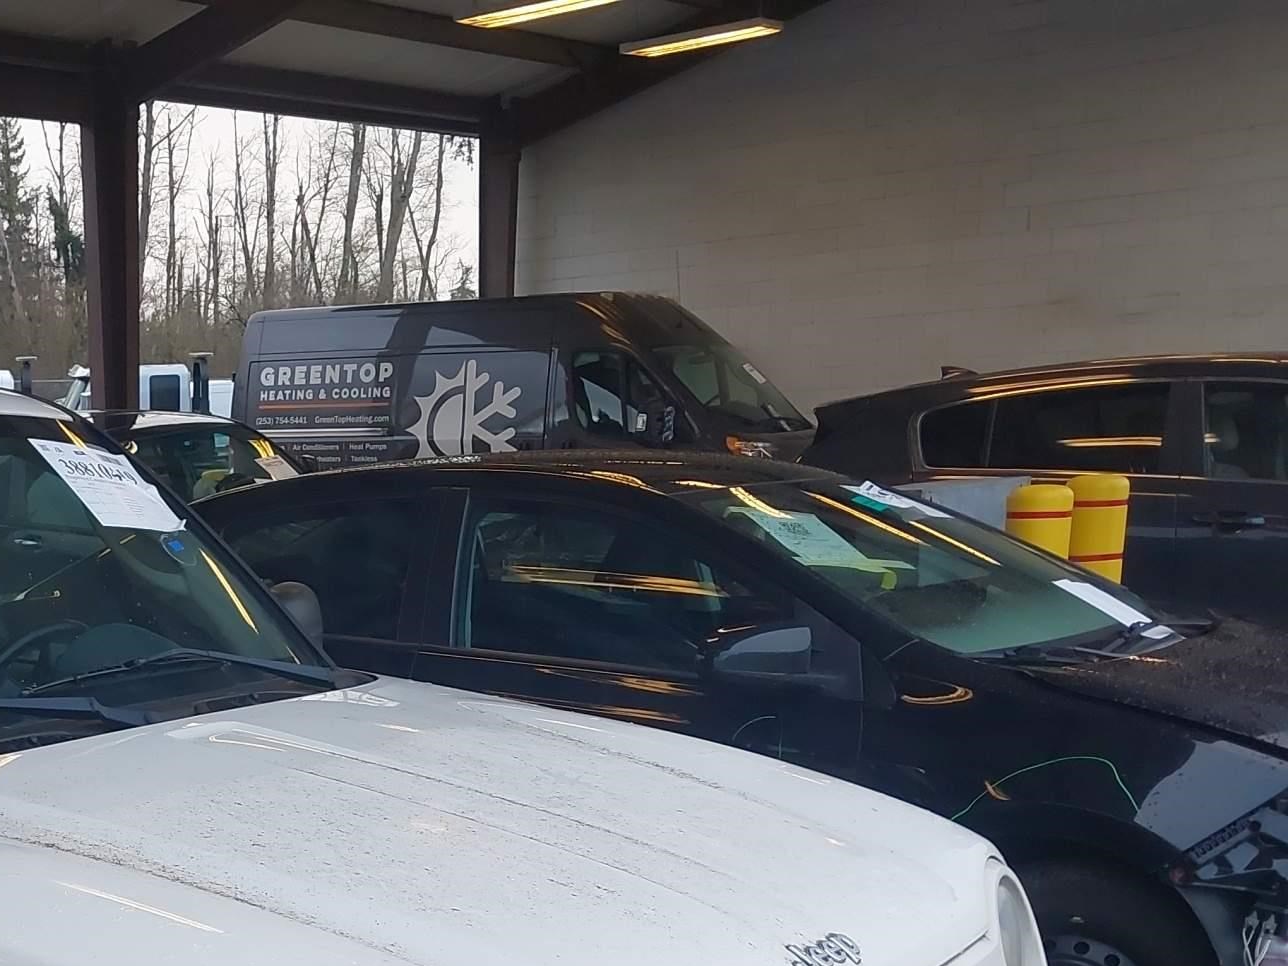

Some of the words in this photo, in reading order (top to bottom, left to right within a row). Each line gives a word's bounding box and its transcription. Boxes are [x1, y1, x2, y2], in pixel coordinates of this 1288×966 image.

[260, 362, 393, 386] GREENTOP
[260, 389, 313, 401] HEATING
[319, 388, 326, 399] &
[332, 387, 391, 399] COOLING
[255, 416, 274, 425] (253)
